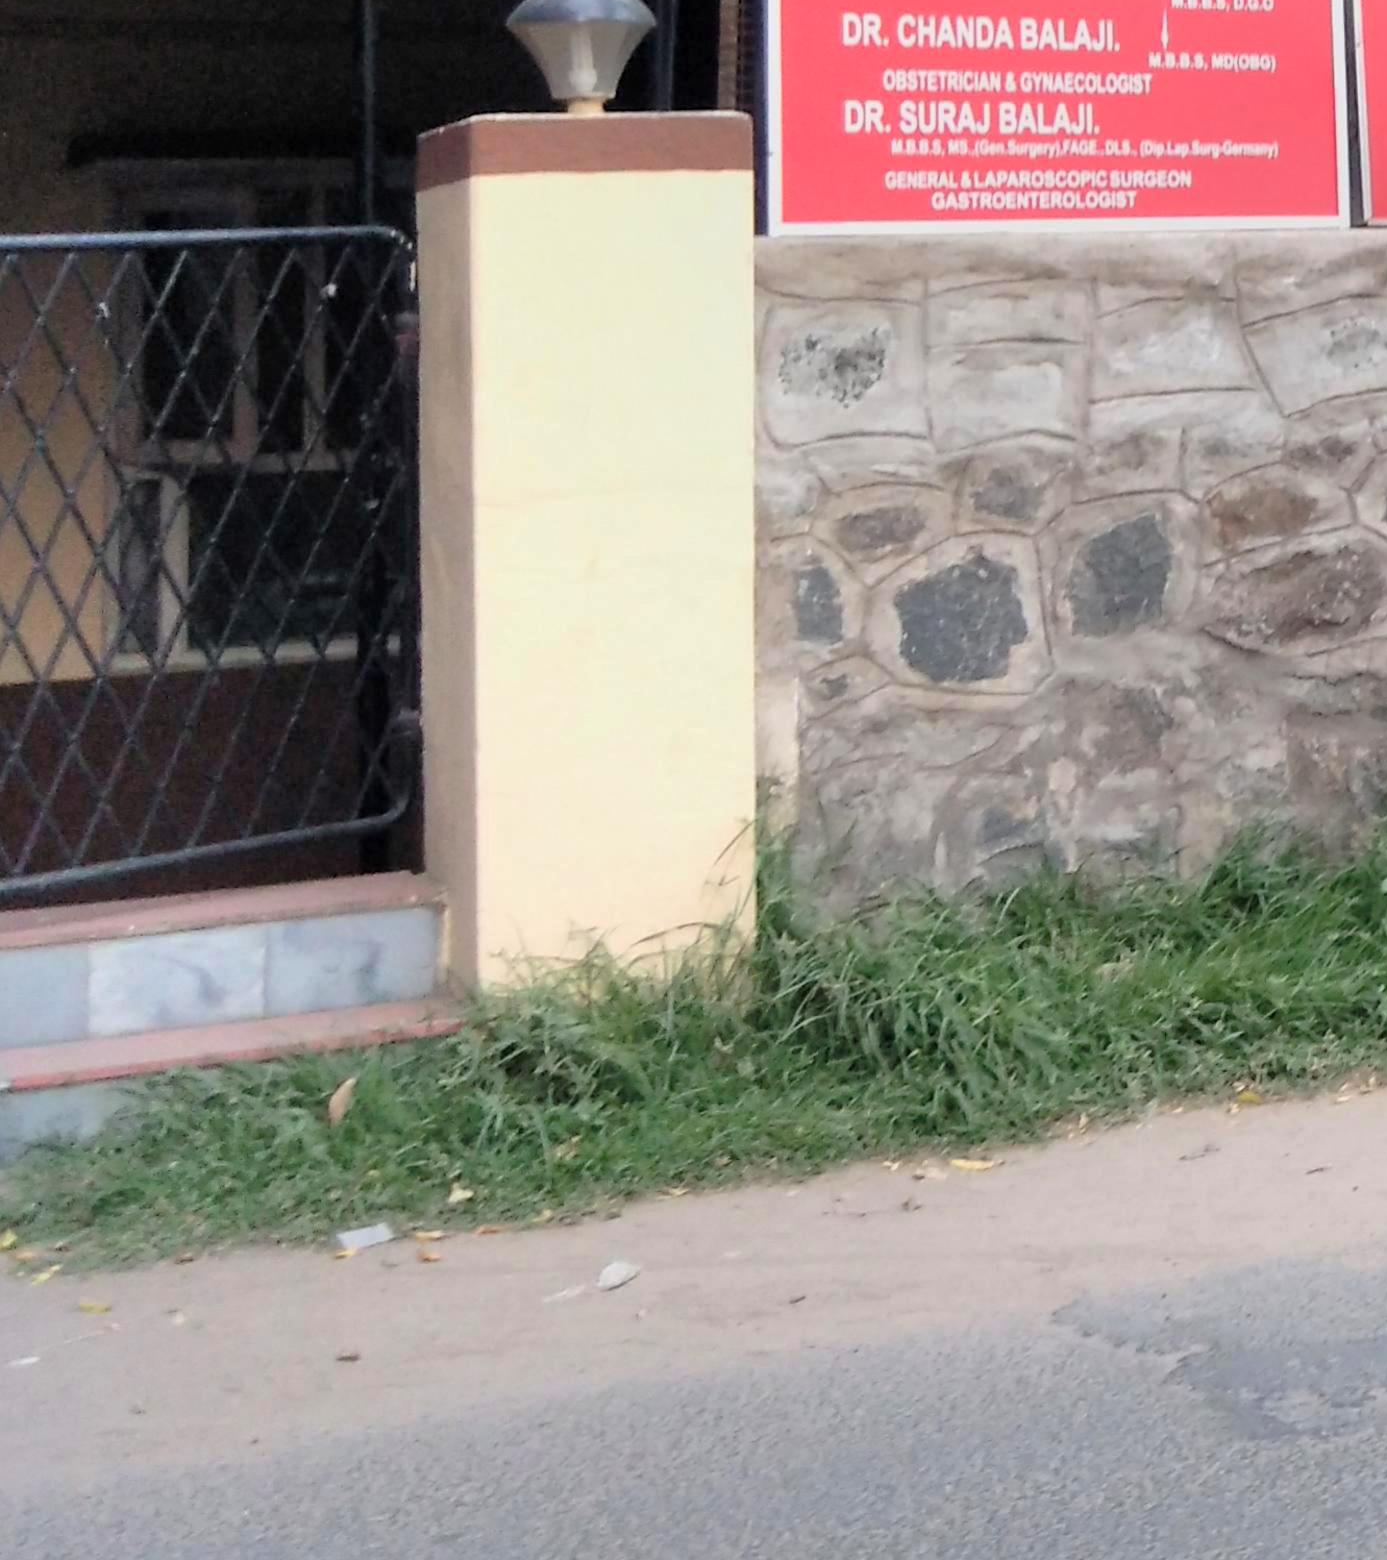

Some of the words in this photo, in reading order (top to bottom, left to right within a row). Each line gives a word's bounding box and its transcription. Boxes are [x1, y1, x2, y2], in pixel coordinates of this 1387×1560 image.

[842, 12, 890, 47] DR.
[897, 14, 1014, 49] CHANDA
[1020, 17, 1120, 52] BALAJI.
[883, 68, 1001, 92] OBSTETRICIAN
[1005, 72, 1016, 93] &
[1020, 70, 1152, 94] GYNAECOLOGIST
[844, 99, 892, 134] DR.
[899, 100, 991, 134] SURAJ
[998, 102, 1100, 135] BALAJI.
[885, 171, 957, 189] GENERAL
[961, 171, 972, 189] &
[974, 171, 1107, 188] LAPAROSCOPIC
[1110, 170, 1192, 188] SURGEON
[931, 191, 1137, 210] GASTROENTEROLOGIST
